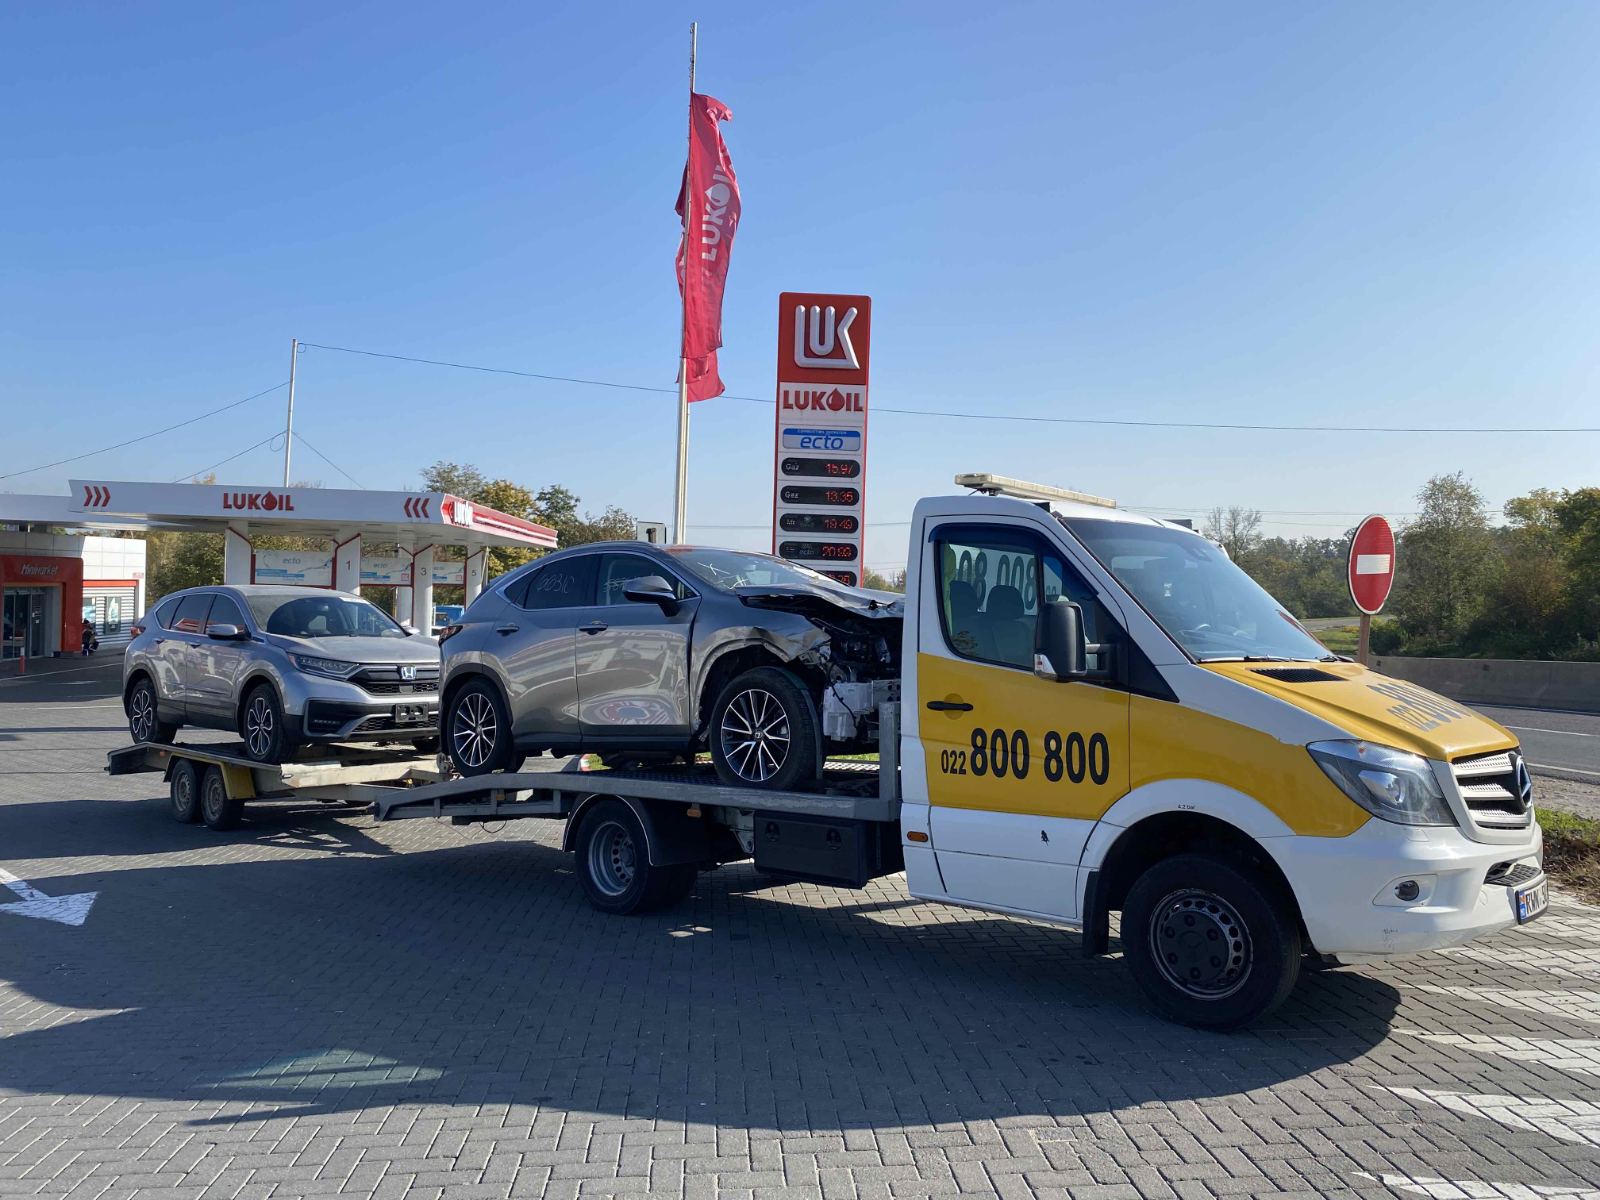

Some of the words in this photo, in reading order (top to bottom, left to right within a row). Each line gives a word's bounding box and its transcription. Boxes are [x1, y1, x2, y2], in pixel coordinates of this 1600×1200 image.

[783, 387, 864, 412] LUKOIL
[800, 435, 844, 450] ecto
[223, 490, 295, 511] LUKOIL
[345, 560, 351, 571] 1
[420, 567, 427, 576] 3
[471, 569, 477, 577] 5
[941, 750, 967, 775] 022
[970, 728, 1030, 780] 800
[1044, 731, 1110, 785] 800
